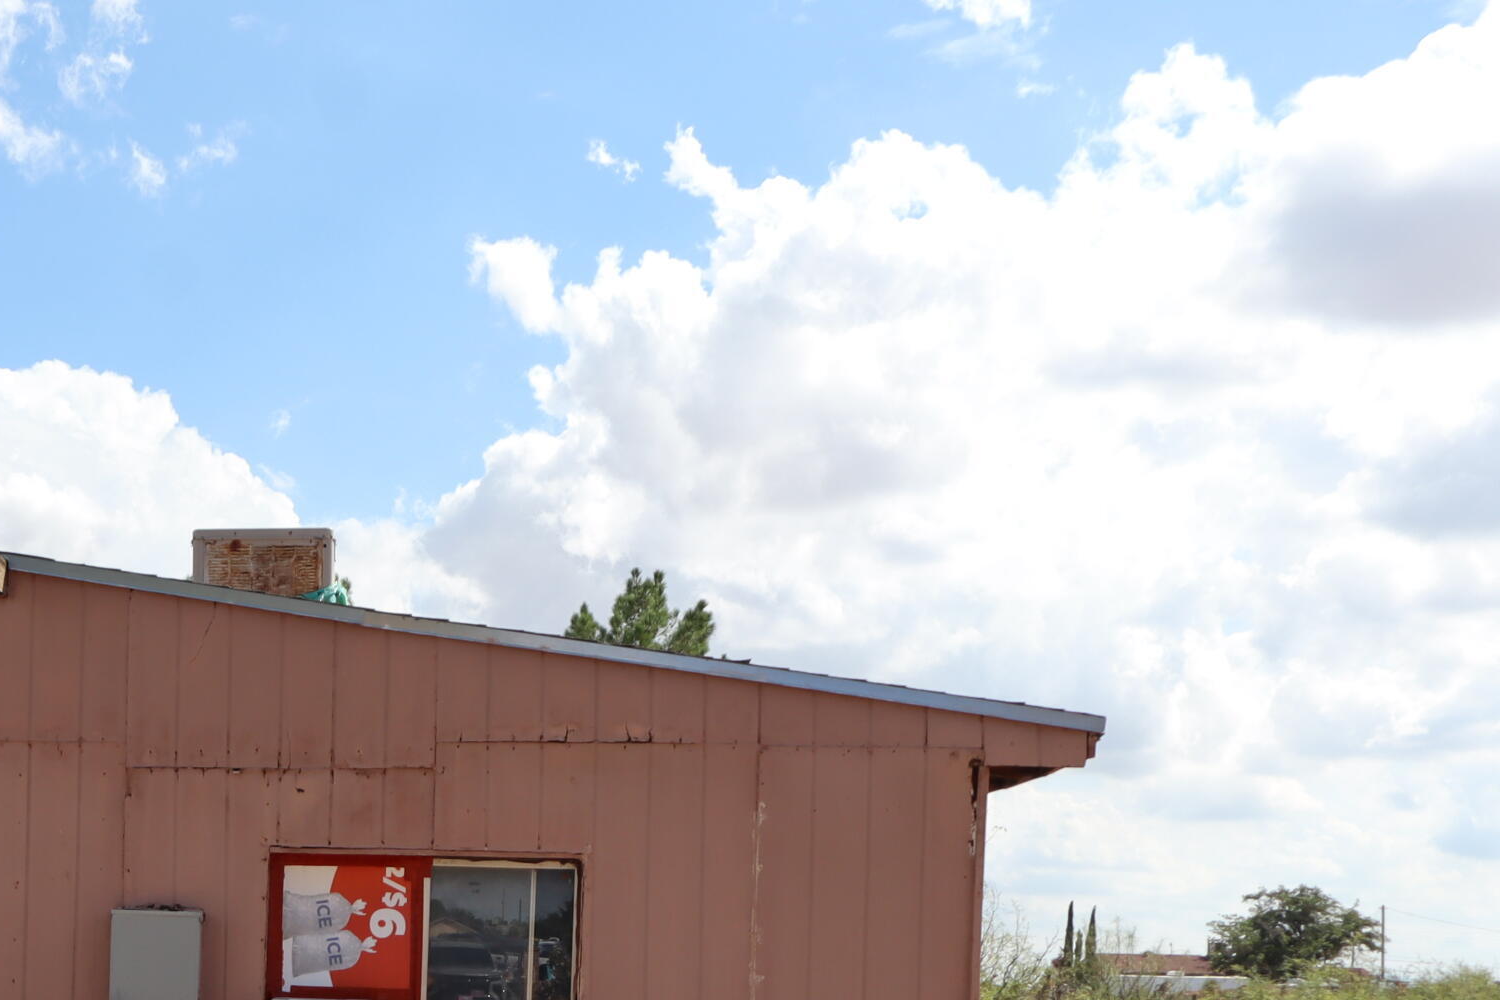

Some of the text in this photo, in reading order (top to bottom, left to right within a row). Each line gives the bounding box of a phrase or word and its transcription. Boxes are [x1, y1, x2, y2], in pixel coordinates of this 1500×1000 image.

[316, 900, 332, 928] ICE
[369, 866, 408, 939] 2/$6
[326, 937, 343, 966] ICE
